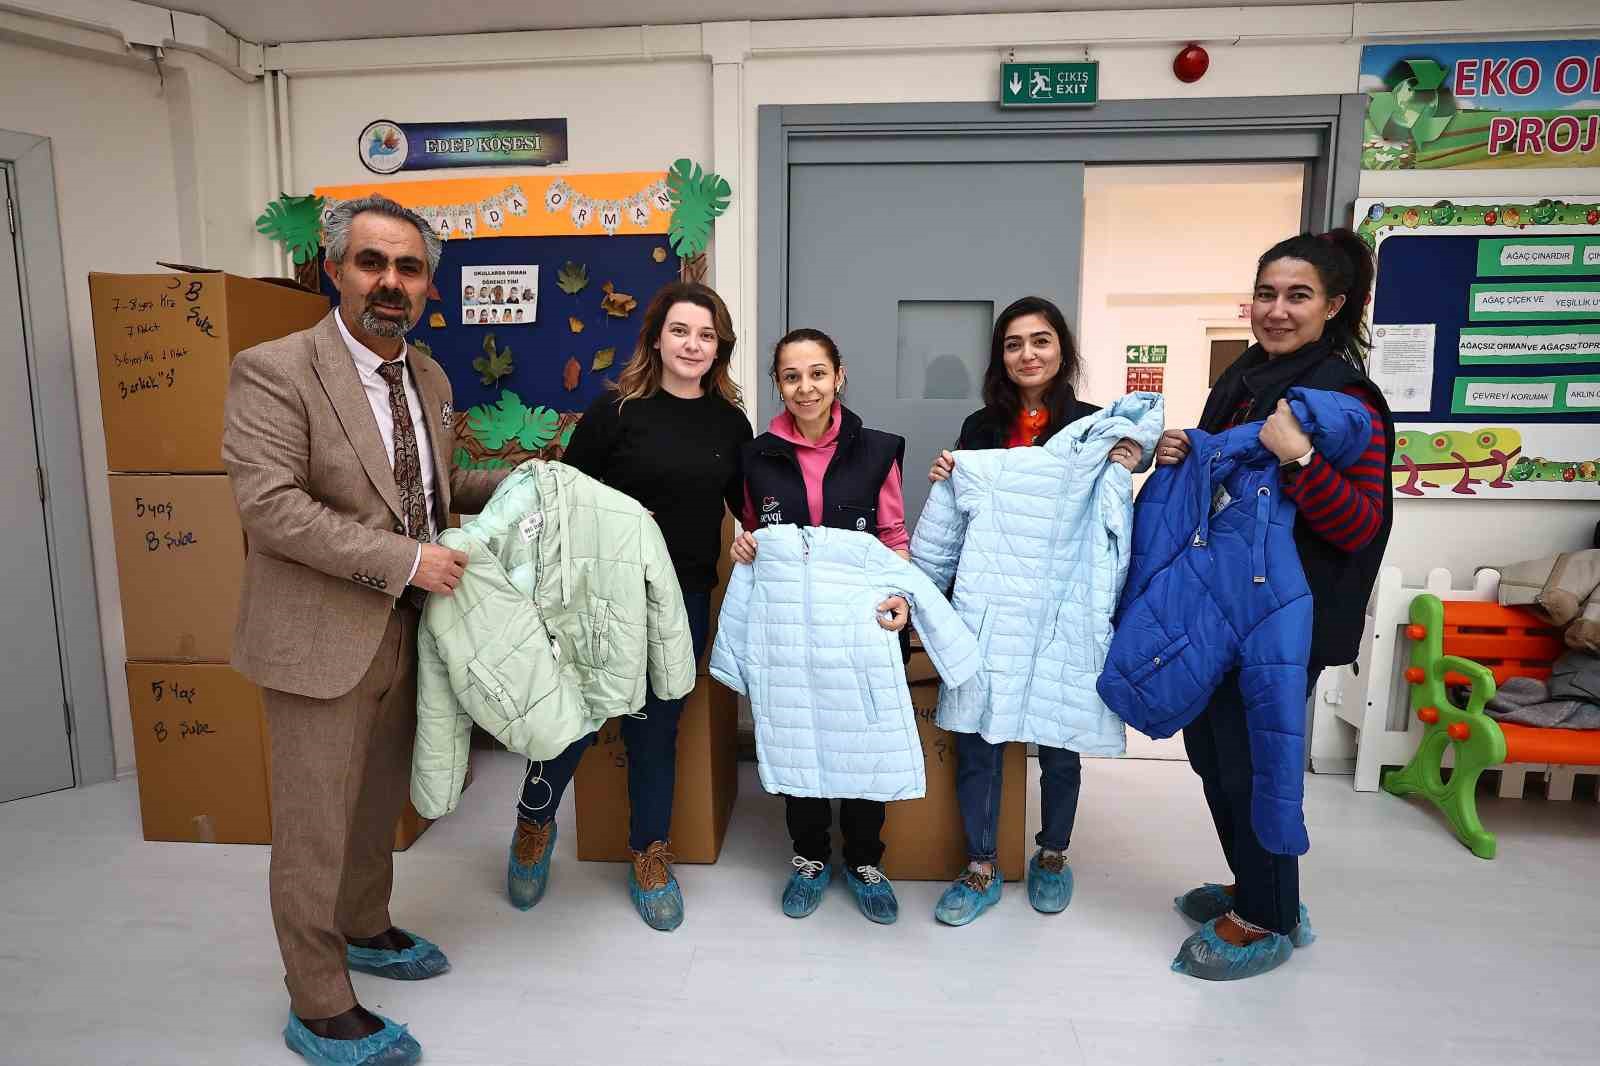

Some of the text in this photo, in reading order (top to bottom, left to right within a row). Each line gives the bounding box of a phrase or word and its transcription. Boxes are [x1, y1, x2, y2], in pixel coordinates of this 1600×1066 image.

[1057, 71, 1089, 84] ÇIKIŞ
[1453, 57, 1542, 97] EKO
[1056, 84, 1087, 94] EXIT
[425, 132, 543, 155] EDEP KÖŞESİ
[550, 192, 671, 227] ORMAN
[1505, 251, 1571, 261] AĞAÇ ÇINARDIR
[1482, 296, 1506, 305] AĞAÇ
[1506, 295, 1532, 305] ÇİÇEK
[1533, 295, 1545, 303] VE
[1460, 342, 1496, 352] AĞAÇSIZ
[1496, 342, 1527, 350] ORMAN
[1540, 342, 1577, 352] AĞAÇSIZ
[1472, 391, 1550, 401] ÇEVREYİ KORUMAK
[1569, 391, 1595, 399] AKLIN
